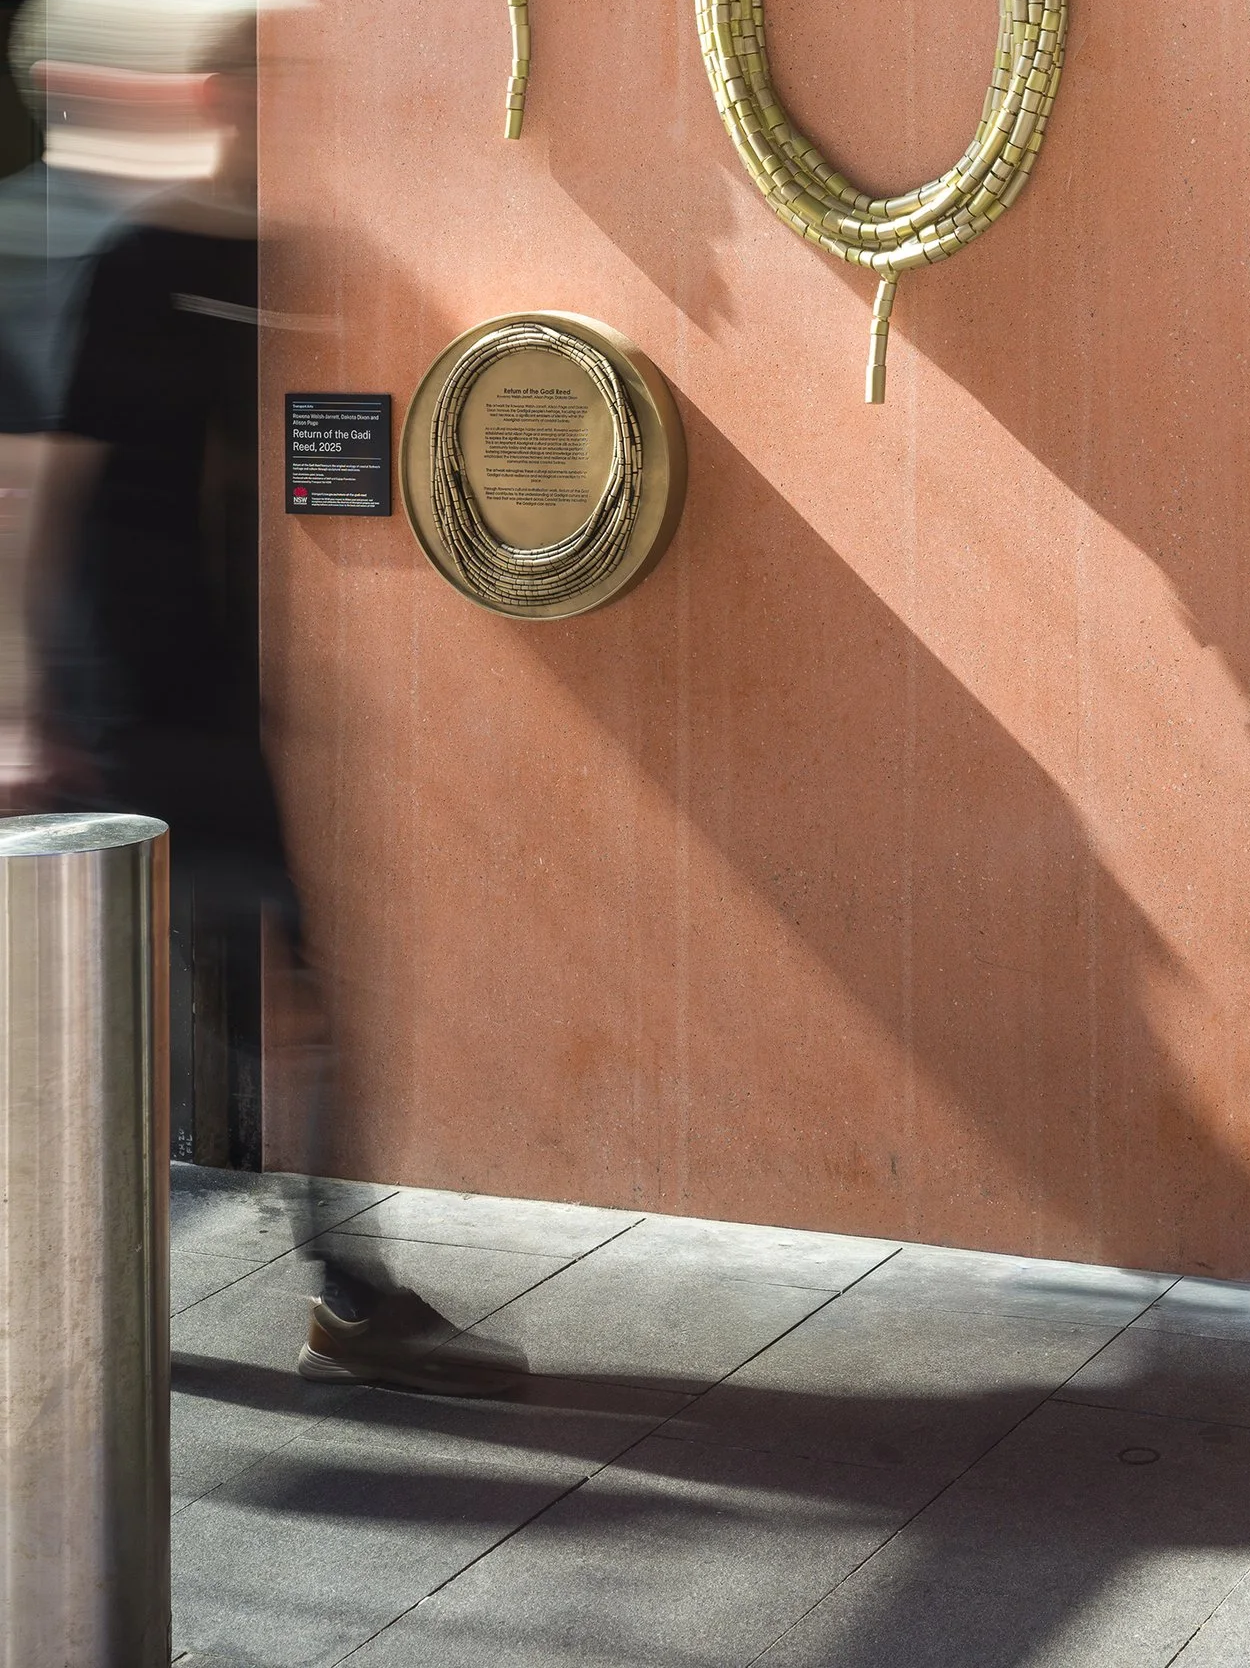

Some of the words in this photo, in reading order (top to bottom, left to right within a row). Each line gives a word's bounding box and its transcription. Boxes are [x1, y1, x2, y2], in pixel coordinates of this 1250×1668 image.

[293, 429, 322, 439] Return
[324, 429, 332, 439] of
[335, 429, 349, 439] the
[351, 430, 371, 440] Gadi
[293, 442, 317, 452] Reed,
[319, 442, 342, 452] 2025
